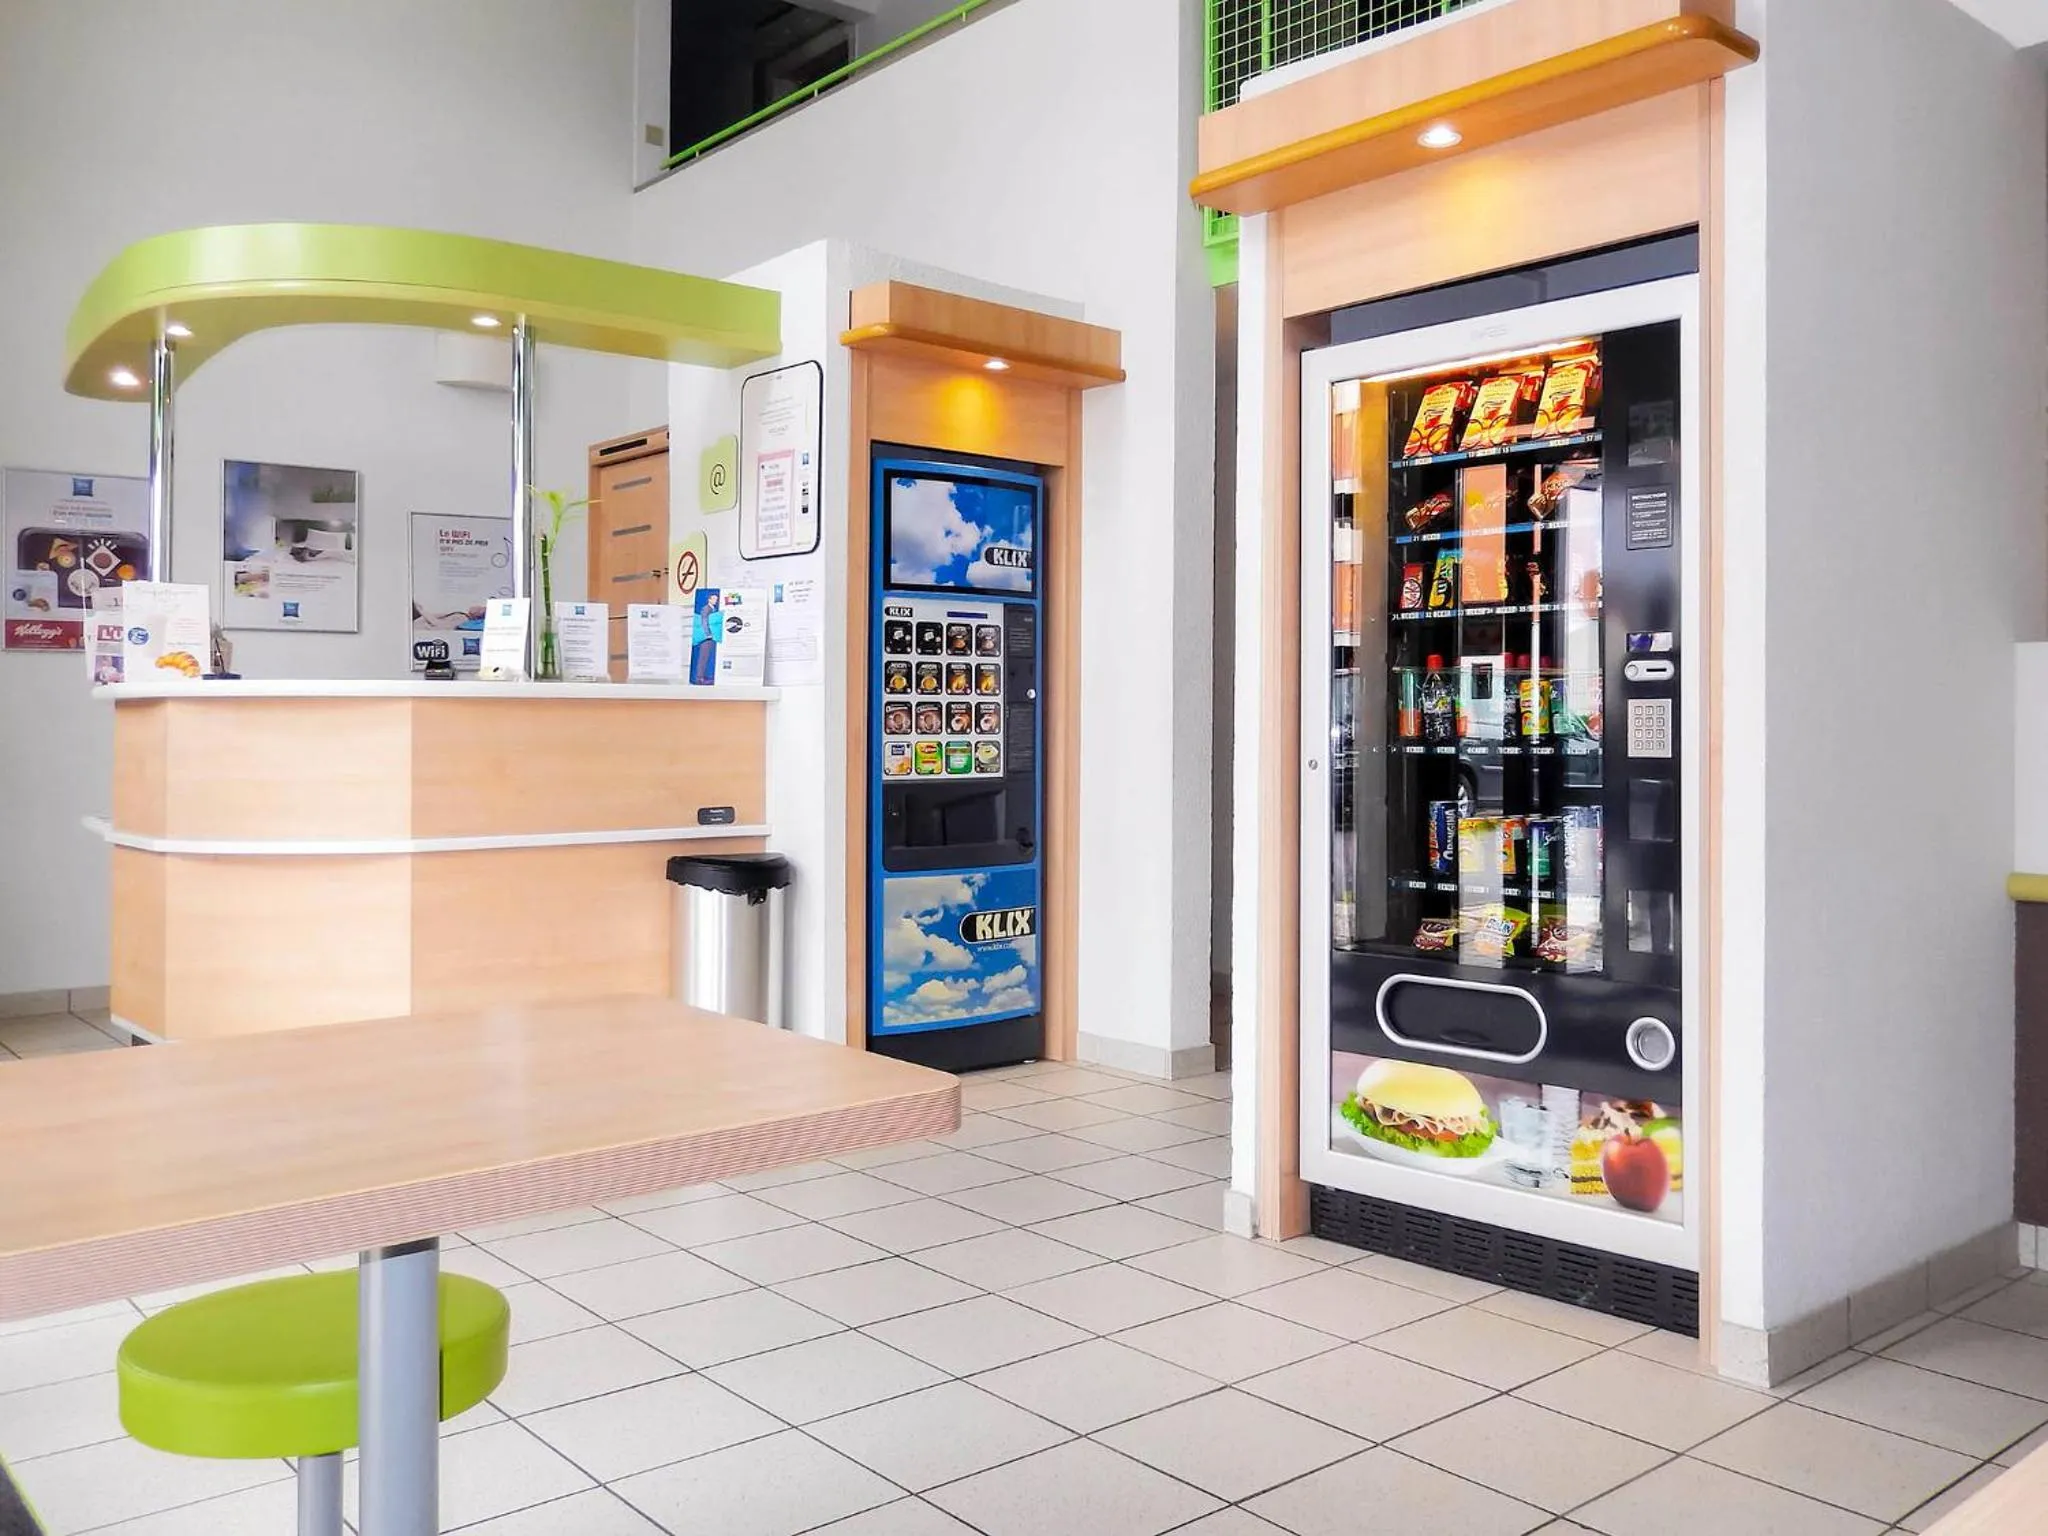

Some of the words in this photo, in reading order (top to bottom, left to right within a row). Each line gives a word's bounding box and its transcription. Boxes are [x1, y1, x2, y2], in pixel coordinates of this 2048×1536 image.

[993, 548, 1028, 567] KLIX
[889, 607, 911, 617] KLIX
[14, 623, 63, 640] Kellogg's
[416, 645, 446, 658] WiFi
[975, 909, 1031, 940] KLIX
